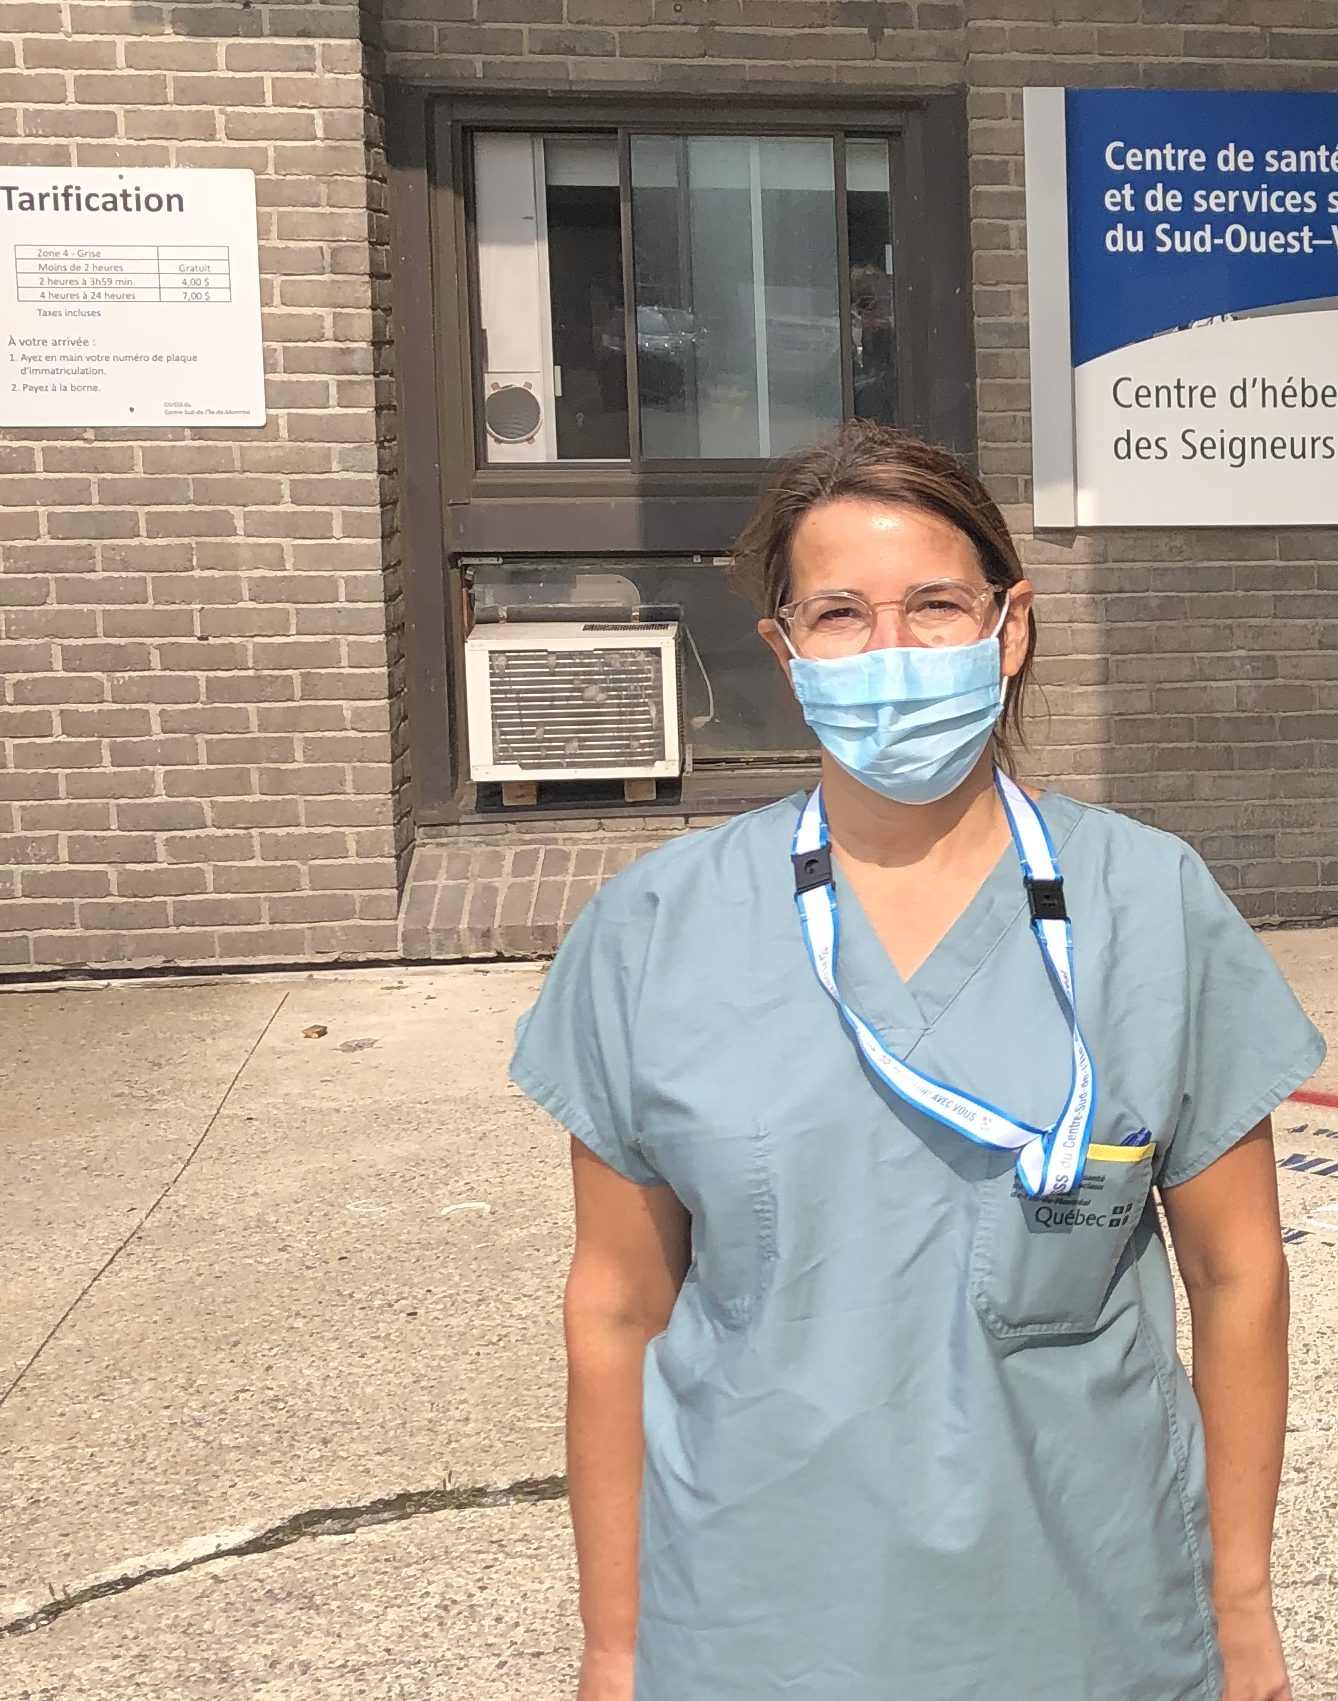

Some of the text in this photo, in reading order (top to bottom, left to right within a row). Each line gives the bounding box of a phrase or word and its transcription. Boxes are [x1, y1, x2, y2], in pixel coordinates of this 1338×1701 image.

[1105, 141, 1206, 172] Centre
[1217, 143, 1254, 172] de
[0, 185, 185, 212] Tarification
[1104, 185, 1134, 212] et
[1145, 184, 1182, 213] de
[1194, 185, 1317, 214] services
[1105, 223, 1144, 253] du
[37, 249, 61, 258] Zone
[63, 249, 69, 258] 4
[77, 249, 101, 258] Grise
[38, 263, 211, 273] Moins de 2 heures Gratuit
[39, 276, 210, 288] 2 heures à 3h59 min. 4,00 $
[40, 290, 211, 302] 4 heures à 24 heures 7,00 $
[37, 308, 101, 318] Taxes incluses
[8, 335, 16, 347] À
[19, 338, 48, 347] votre
[51, 337, 90, 347] arrivée
[9, 353, 18, 362] 1.
[20, 353, 43, 364] Ayez
[59, 353, 83, 362] main
[85, 354, 110, 362] votre
[113, 352, 150, 362] numéro
[152, 353, 164, 362] de
[166, 353, 198, 364] plaque
[20, 366, 107, 376] d'immatriculation.
[11, 381, 101, 394] 2. Payez à la borne.
[1112, 377, 1217, 409] Centre
[1113, 429, 1336, 468] des Seigneurs
[931, 1093, 977, 1122] AVEC VOUS
[1035, 1206, 1107, 1228] Québec
